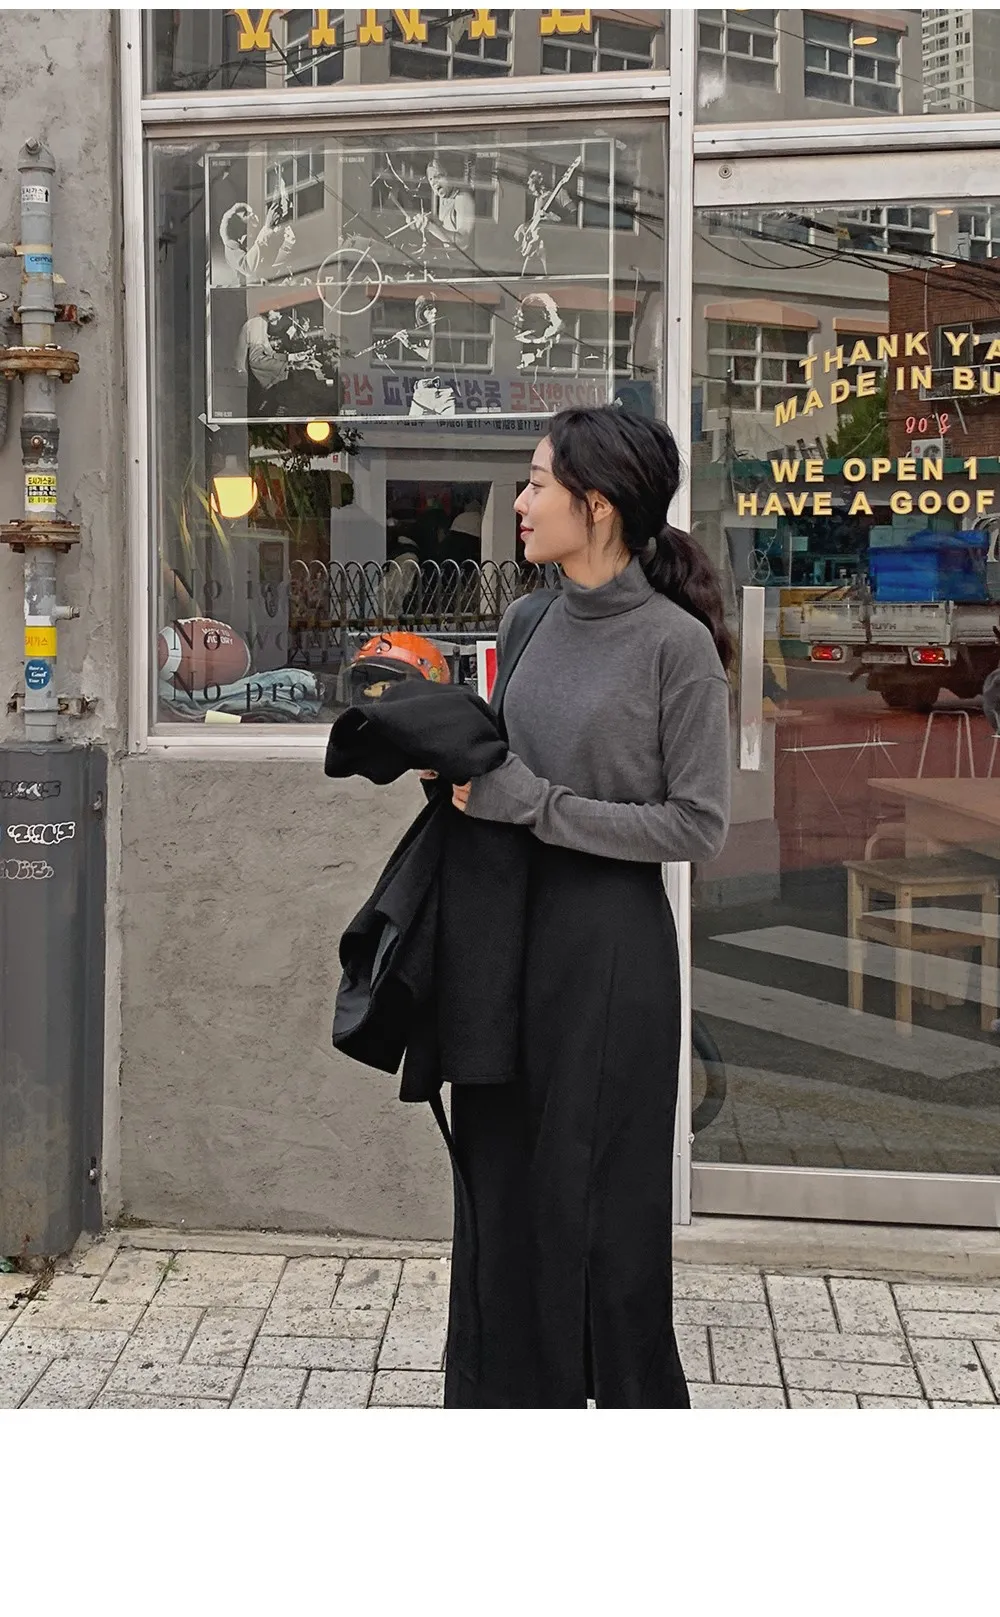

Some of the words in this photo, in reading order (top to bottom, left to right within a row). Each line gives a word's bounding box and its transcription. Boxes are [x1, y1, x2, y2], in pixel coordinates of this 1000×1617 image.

[799, 331, 929, 382] THANK
[774, 371, 876, 428] MADE
[896, 365, 932, 391] IN
[771, 458, 825, 483] WE
[843, 457, 944, 482] OPEN
[963, 457, 978, 480] 1
[737, 490, 833, 516] HAVE
[848, 490, 873, 515] A
[889, 488, 995, 515] GOOF
[171, 568, 222, 600] No
[171, 620, 222, 651] No
[171, 671, 222, 702] No
